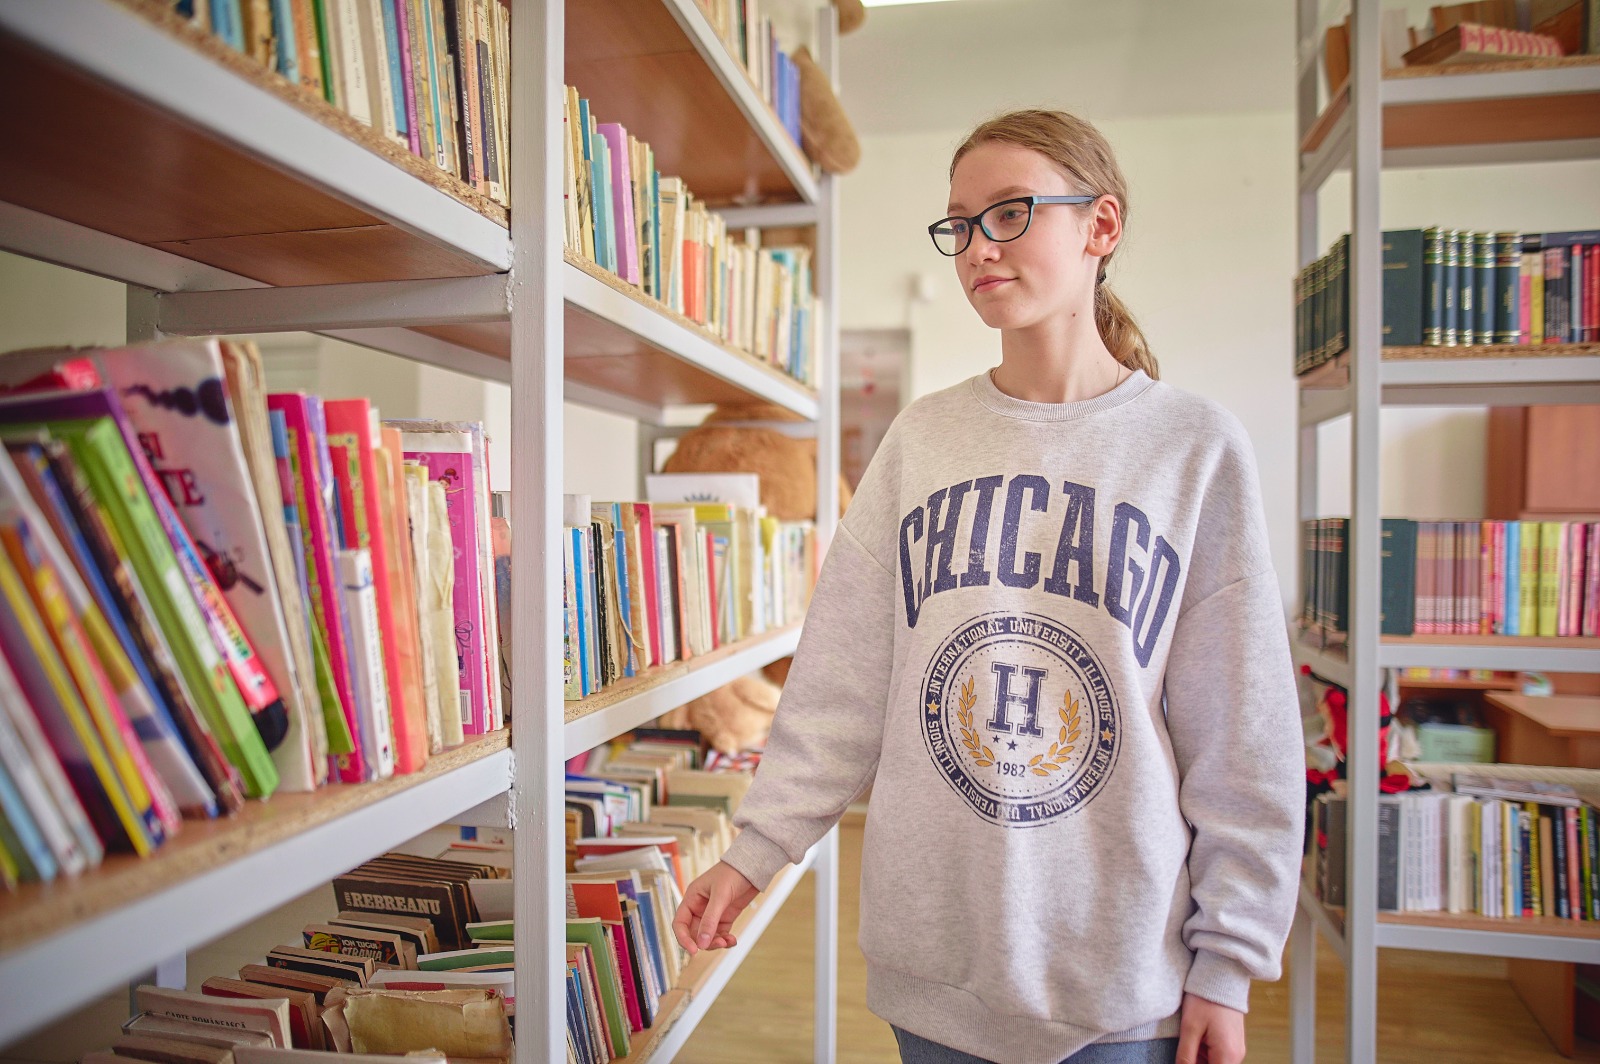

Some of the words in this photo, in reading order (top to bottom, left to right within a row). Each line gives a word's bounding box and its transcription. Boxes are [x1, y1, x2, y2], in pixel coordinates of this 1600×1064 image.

[900, 474, 1181, 668] CHICAGO
[929, 620, 1004, 695] INTERNATIONAL
[1009, 619, 1086, 663] UNIVERSITY
[1082, 663, 1114, 721] ILLINOIS
[986, 661, 1049, 738] H
[928, 720, 957, 774] ILLINOIS
[996, 761, 1026, 777] 1982
[1025, 752, 1110, 820] INTERNATIONAL
[351, 892, 441, 915] REBREANU
